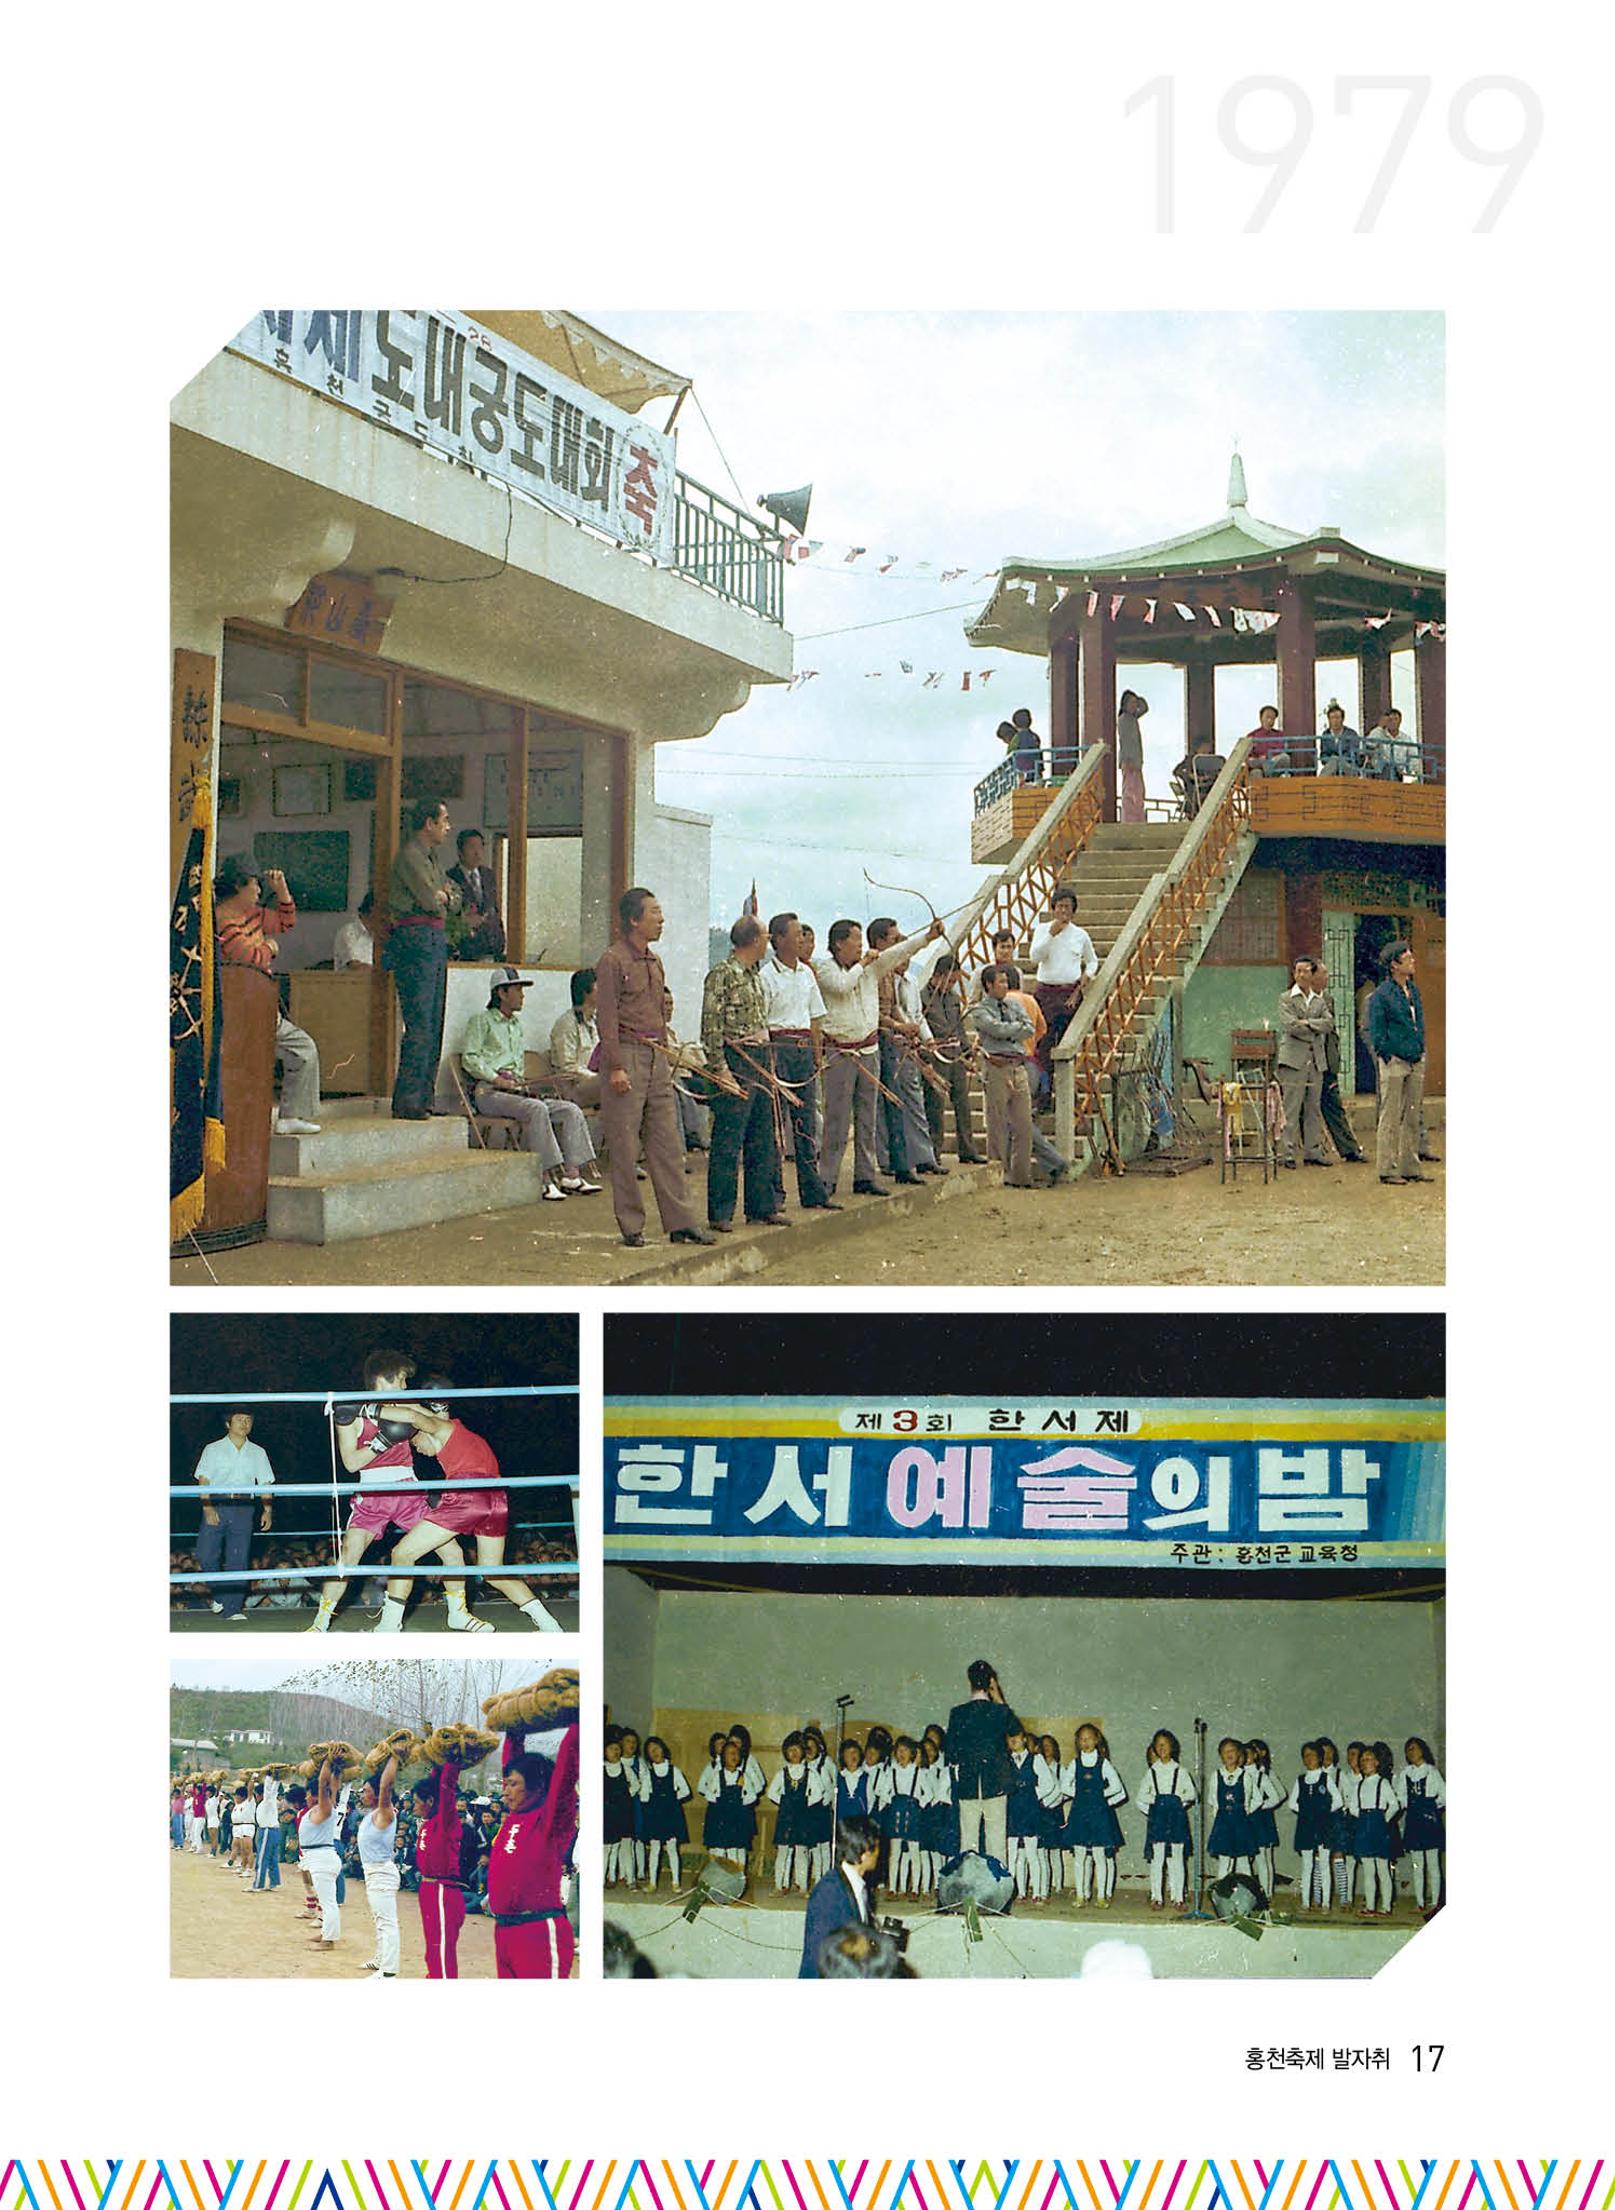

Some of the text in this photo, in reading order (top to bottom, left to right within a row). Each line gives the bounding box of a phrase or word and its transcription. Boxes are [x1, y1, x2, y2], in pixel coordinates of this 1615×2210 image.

[623, 444, 658, 536] 축
[855, 1408, 1129, 1433] 제3회 한서제
[614, 1444, 854, 1528] 한서
[1234, 1544, 1291, 1564] 홍천군
[1298, 1543, 1359, 1563] 교육청
